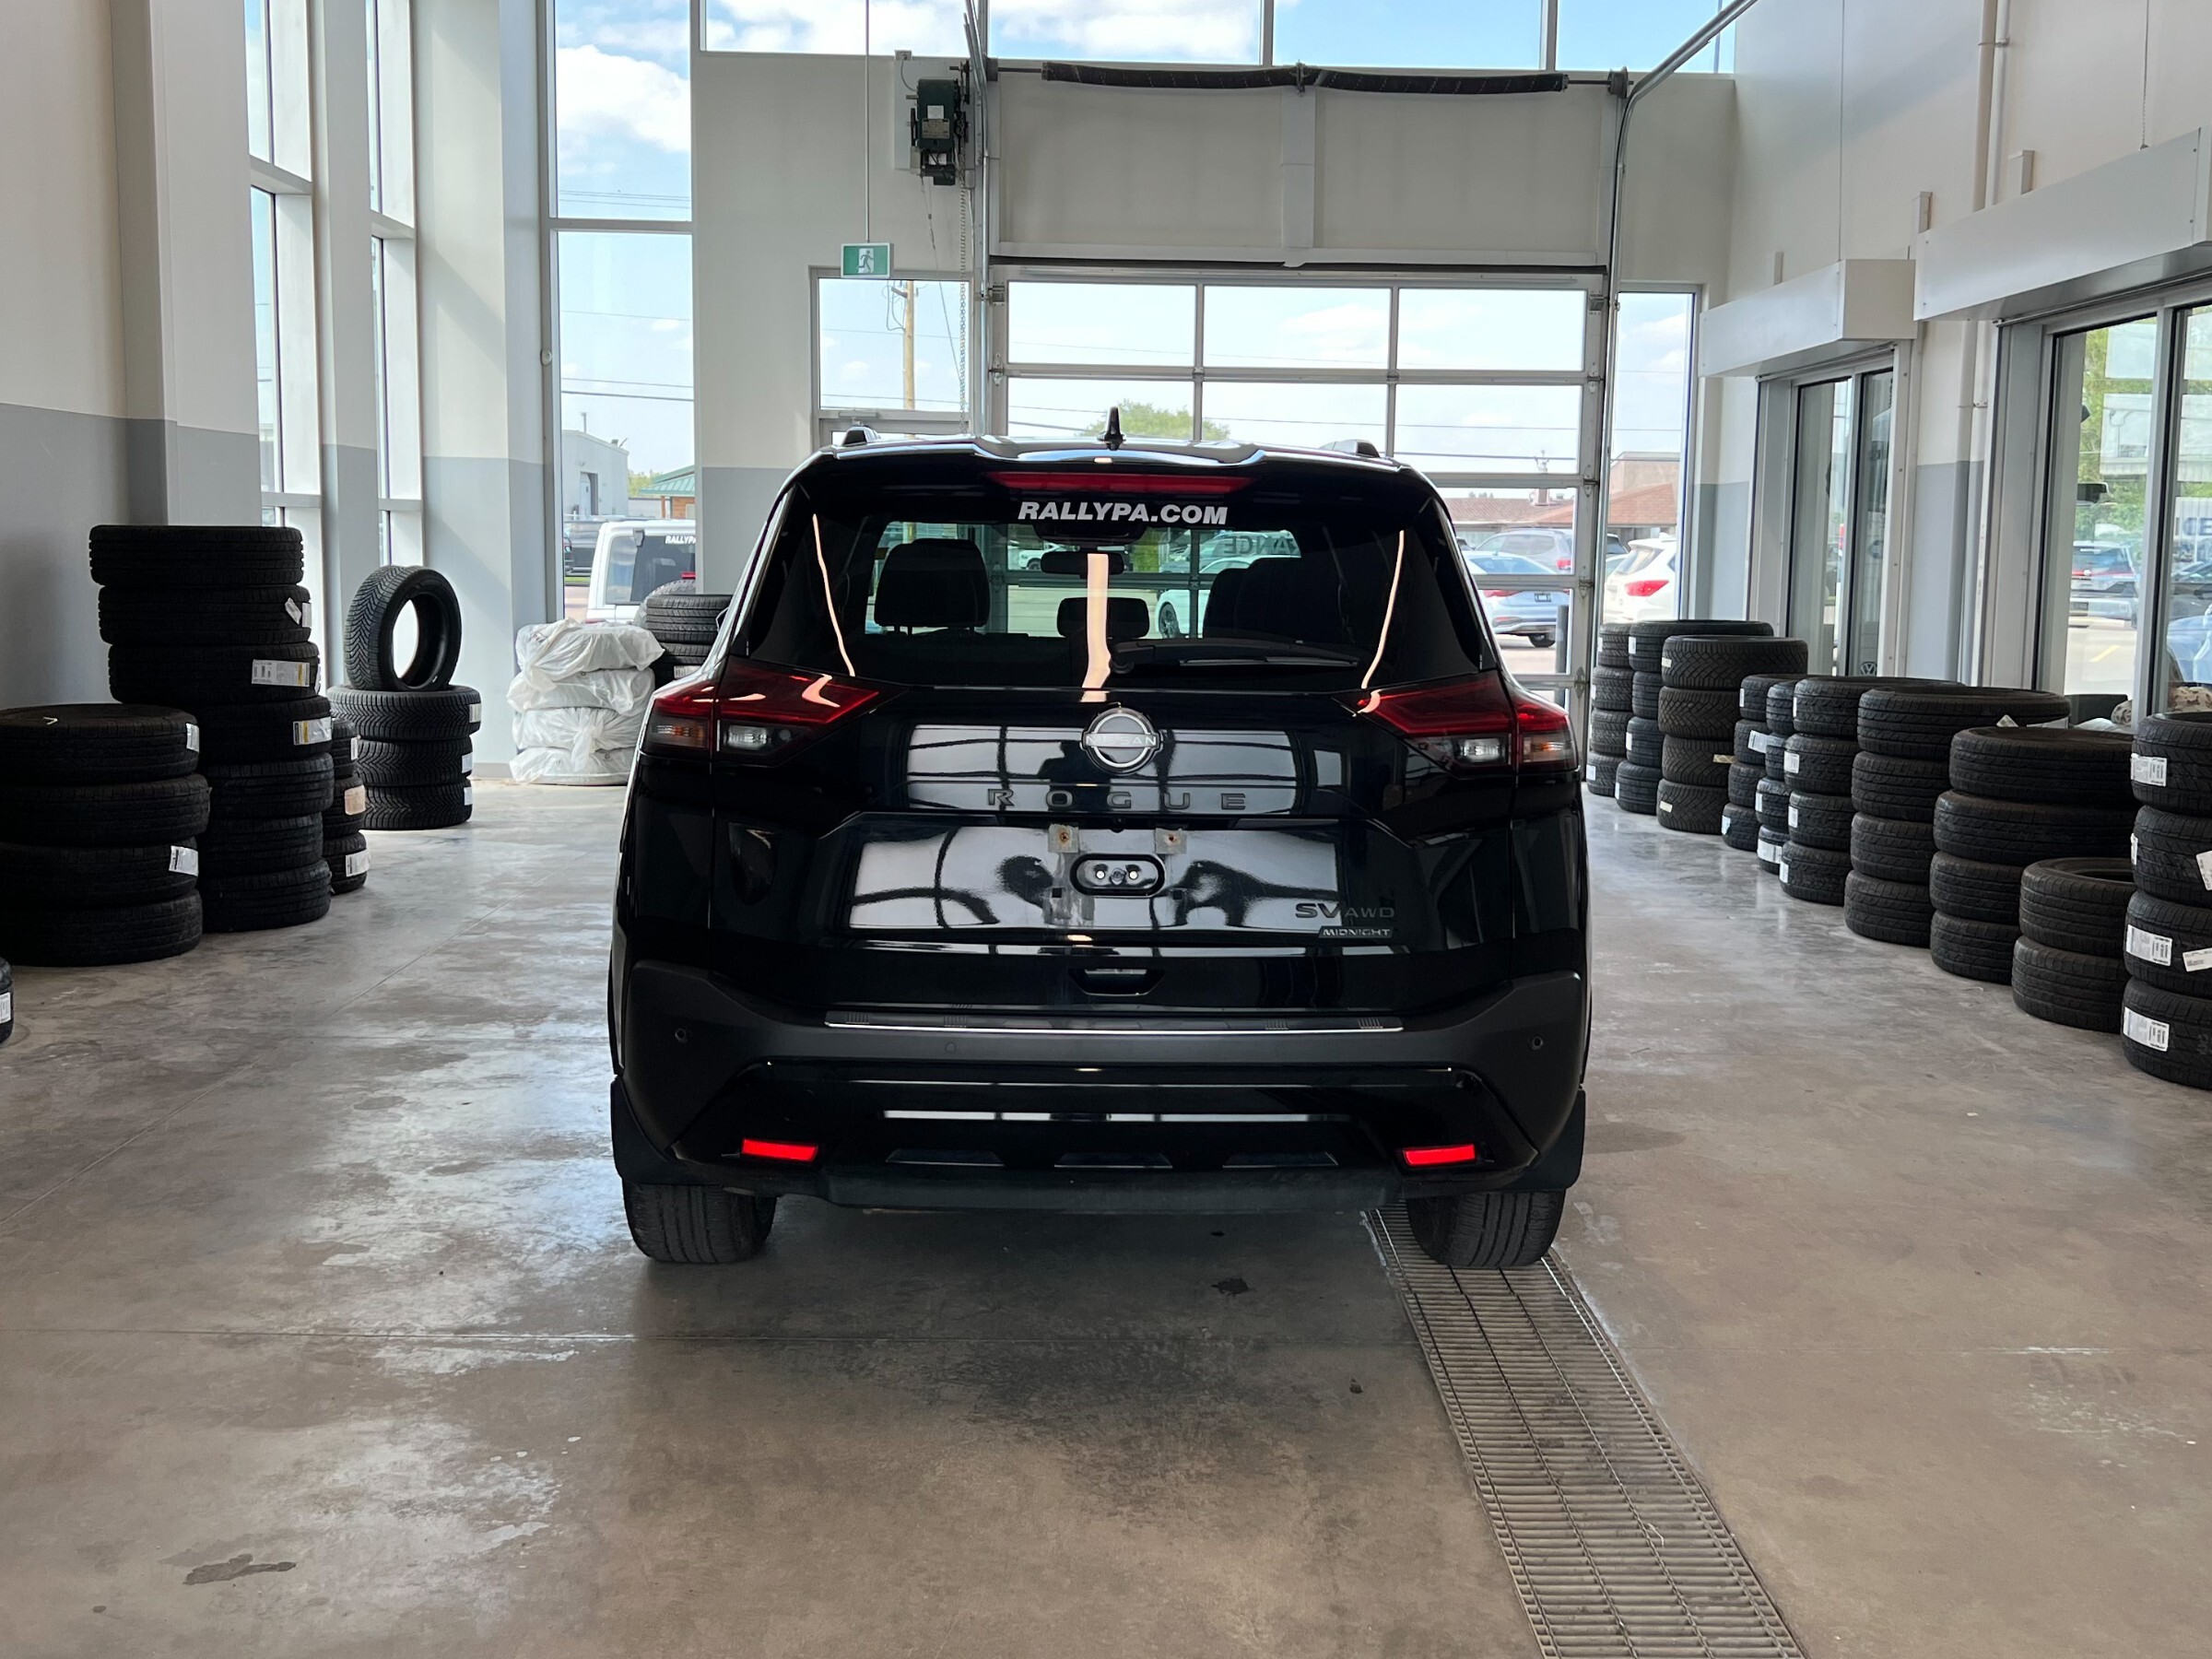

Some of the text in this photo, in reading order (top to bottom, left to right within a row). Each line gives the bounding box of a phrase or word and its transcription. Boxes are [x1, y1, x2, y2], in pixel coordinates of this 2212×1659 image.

[1018, 501, 1228, 524] RALLYPA.COM
[1086, 735, 1157, 746] NISSAN
[987, 788, 1246, 810] ROGUE
[1295, 902, 1394, 918] SV AWD
[1323, 928, 1391, 936] MIDNIGHT
